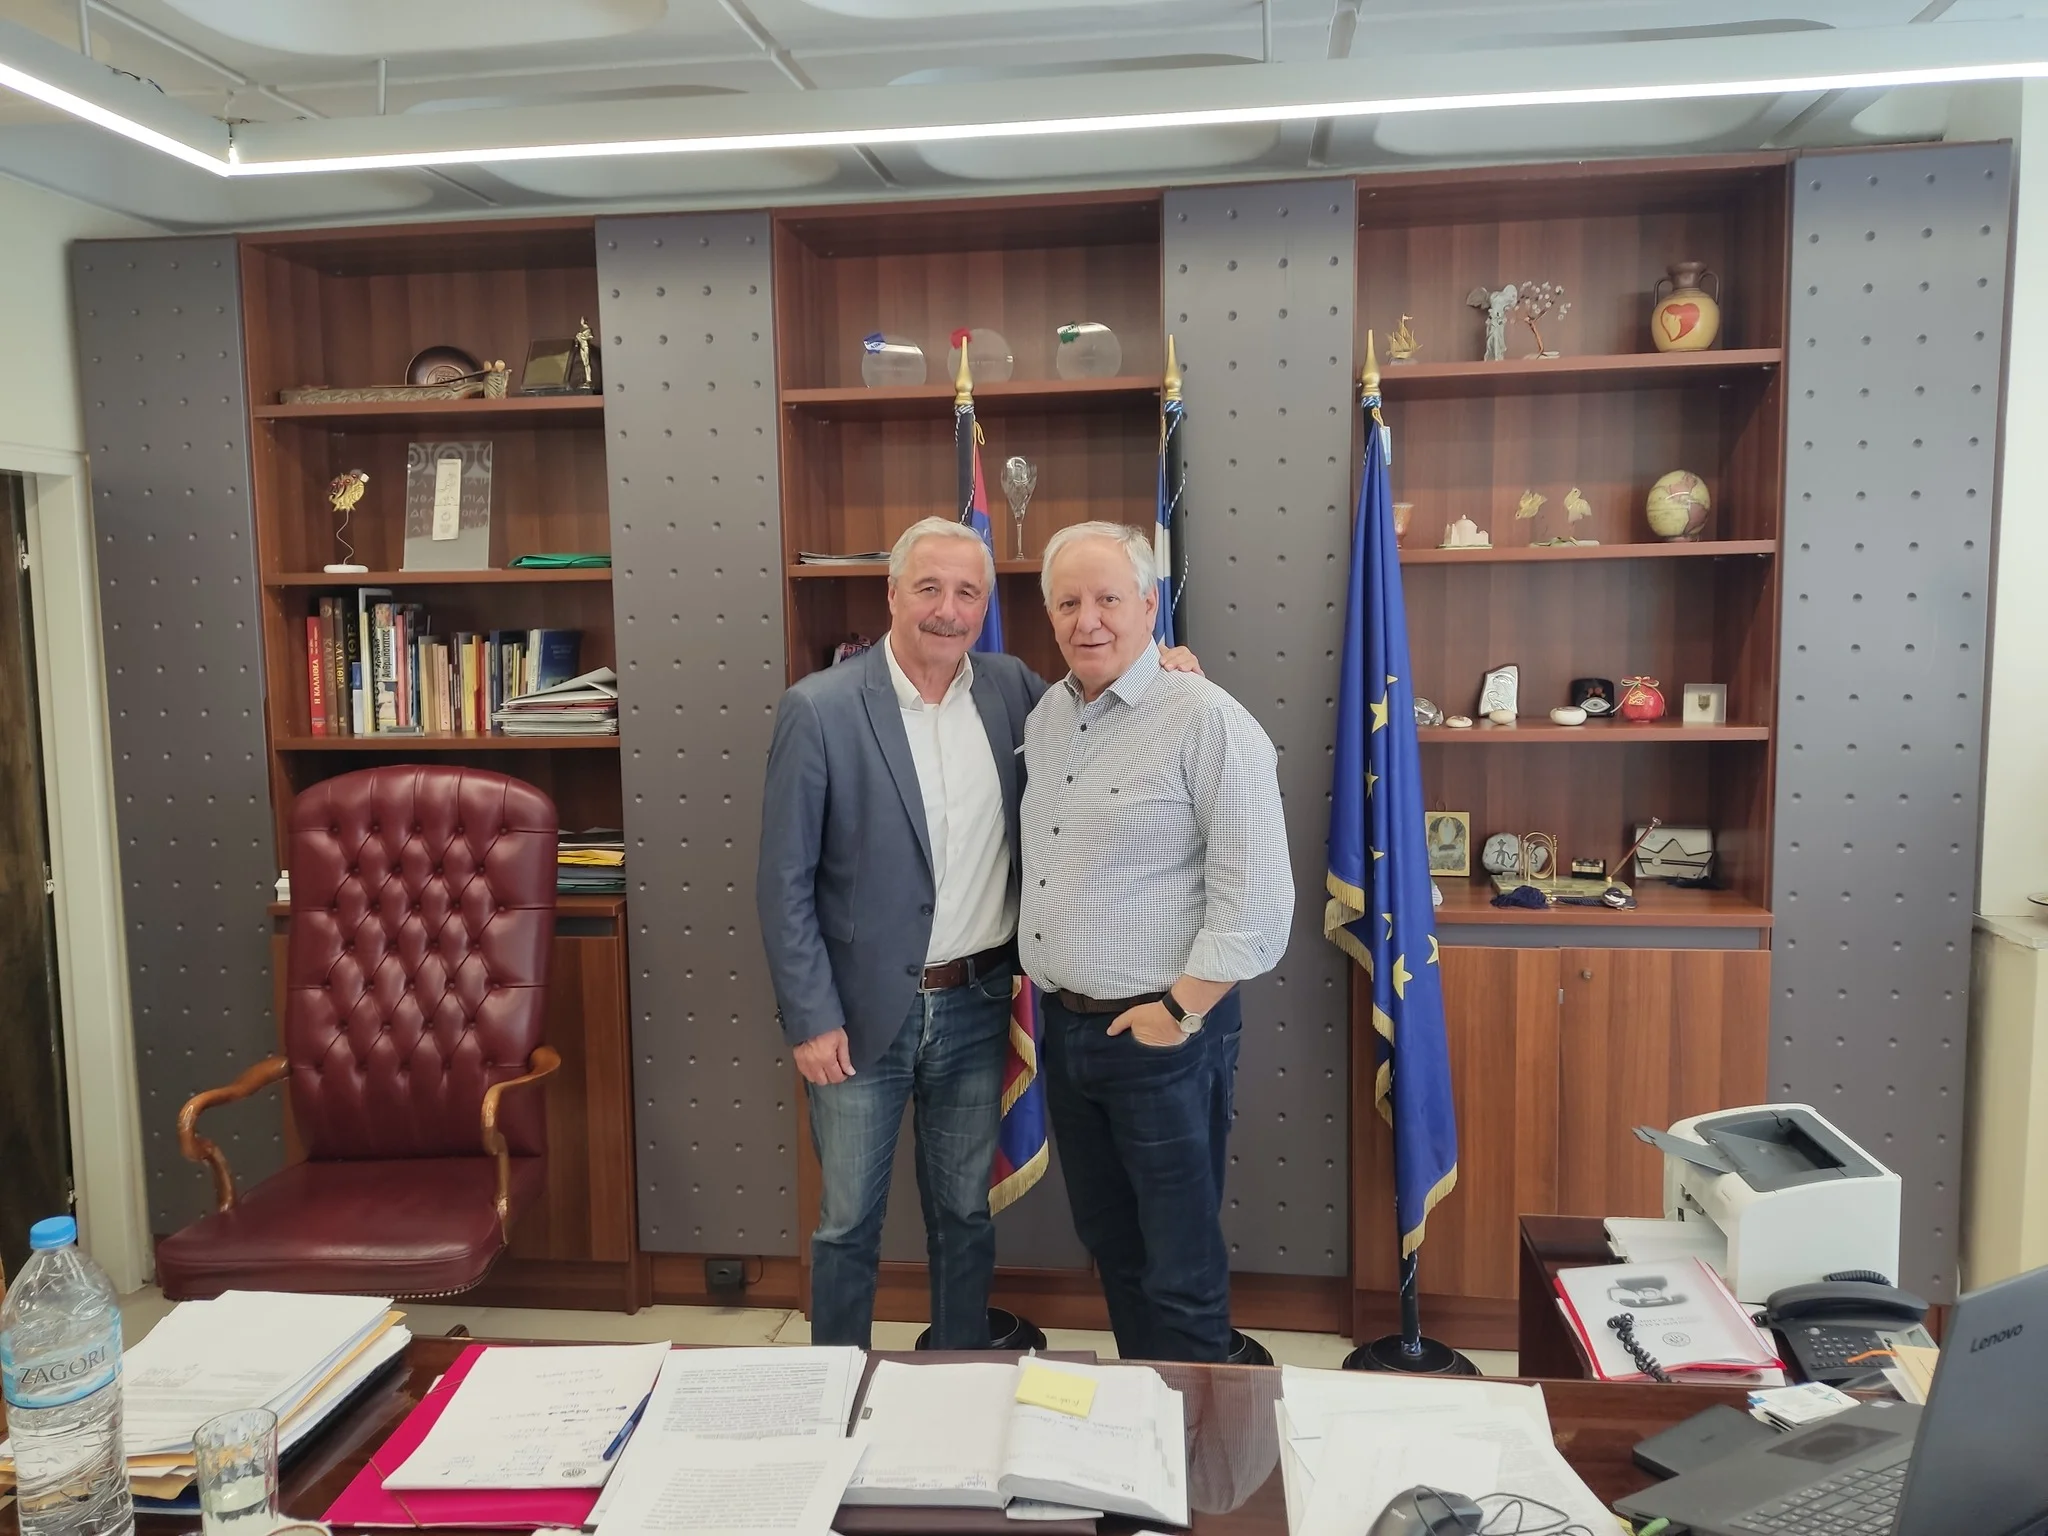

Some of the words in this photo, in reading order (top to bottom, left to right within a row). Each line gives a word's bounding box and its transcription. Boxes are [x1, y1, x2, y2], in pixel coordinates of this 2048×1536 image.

[312, 658, 321, 698] ΚΑΛΛΙΘΕΑ
[1970, 1323, 2024, 1354] Lenovo
[19, 1345, 106, 1384] ZAGORI
